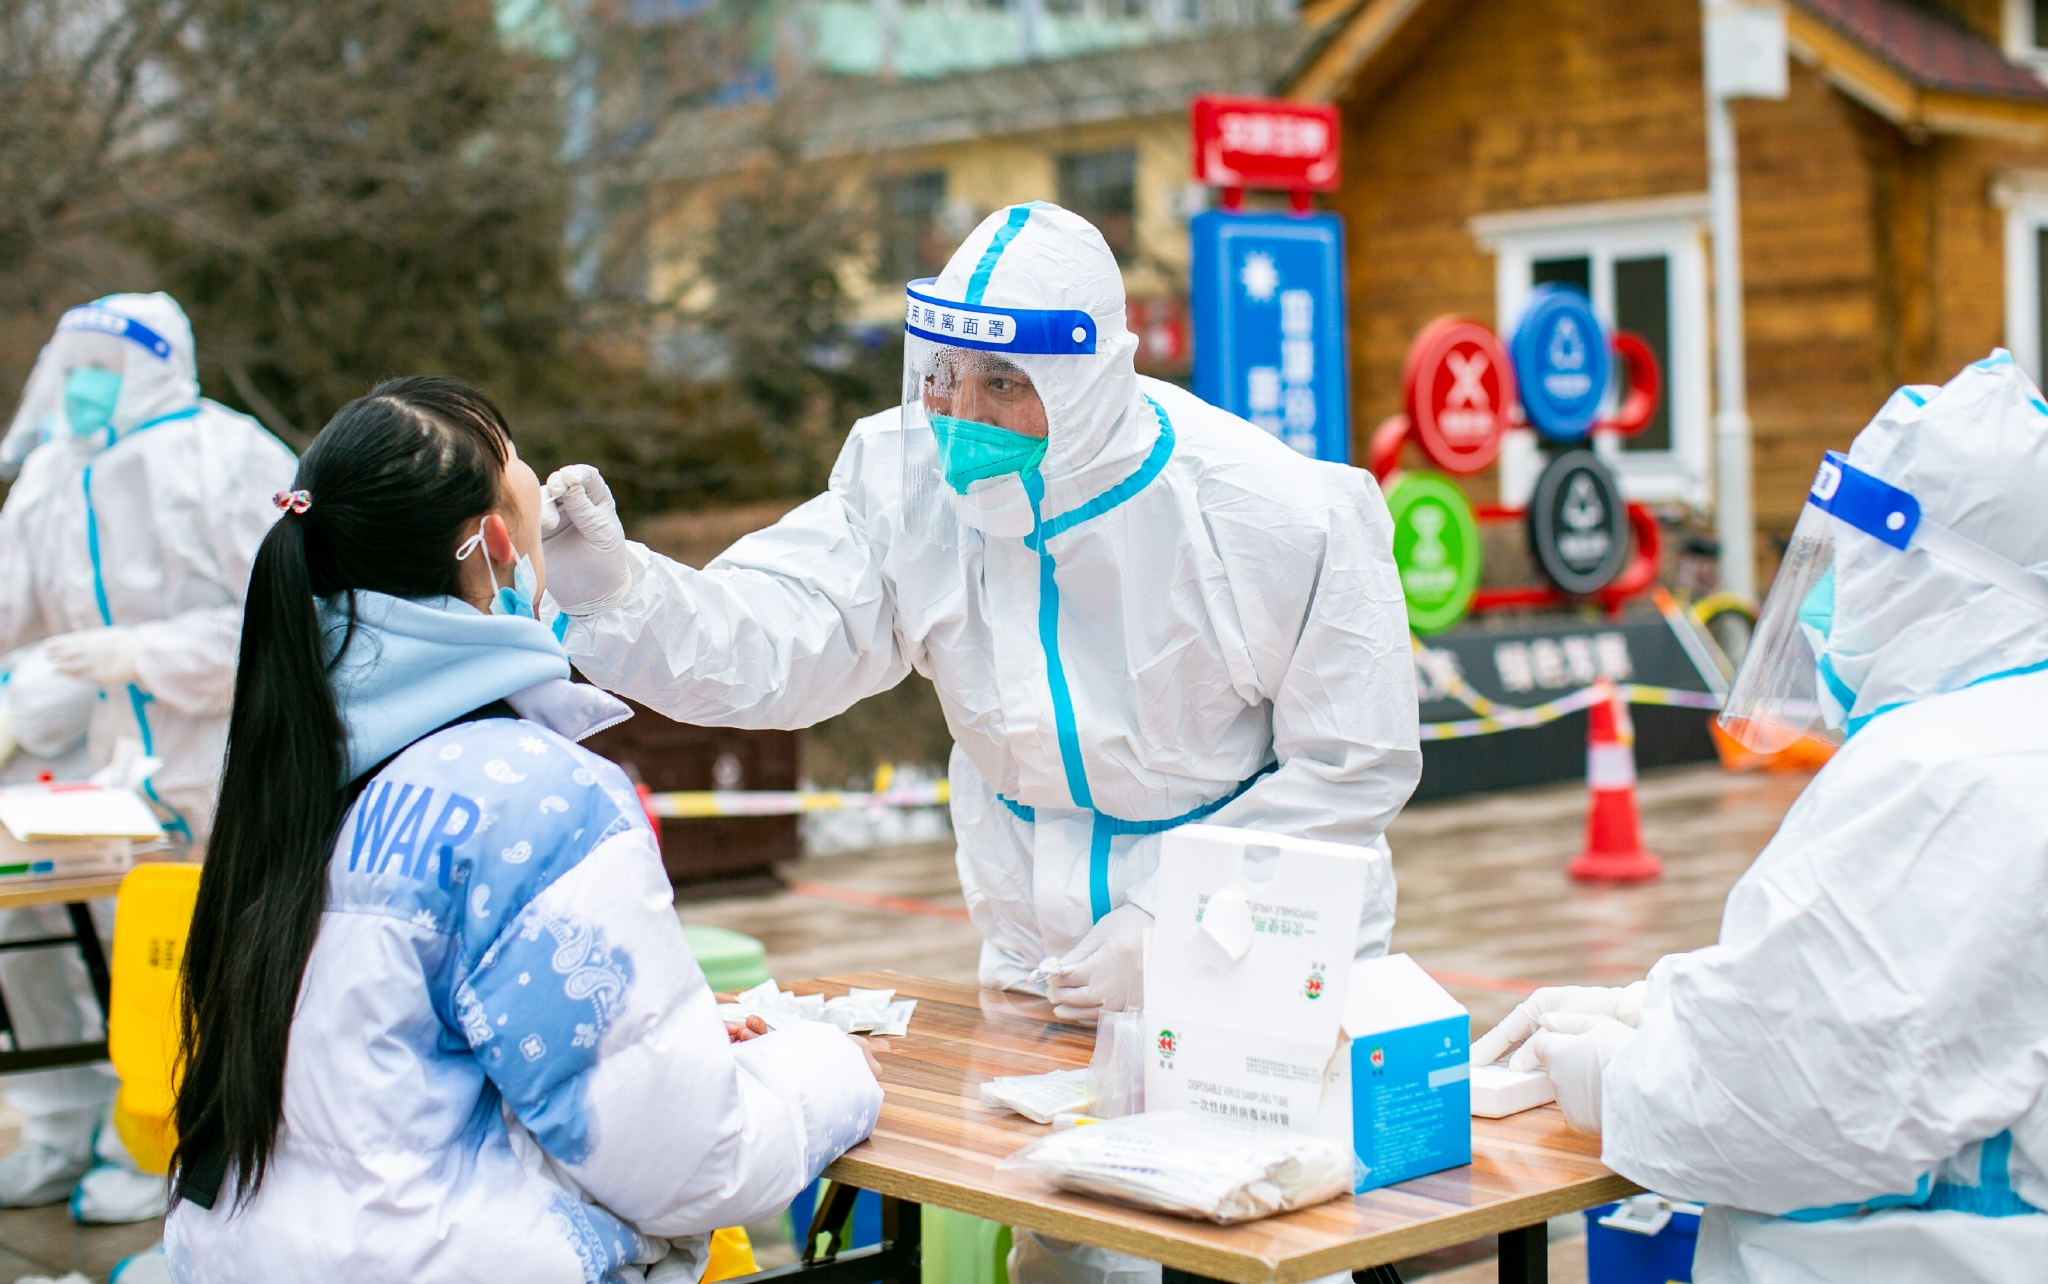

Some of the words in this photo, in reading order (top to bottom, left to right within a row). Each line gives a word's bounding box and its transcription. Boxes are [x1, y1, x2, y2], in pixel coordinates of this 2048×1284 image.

[1252, 915, 1316, 938] 一次性使用
[1187, 1079, 1222, 1097] DISPOSABLE
[1222, 1086, 1241, 1100] VIRUS
[1241, 1089, 1272, 1106] SAMPLING
[1272, 1095, 1290, 1109] TUBE
[1190, 1098, 1290, 1128] 一次性使用病毒采样管
